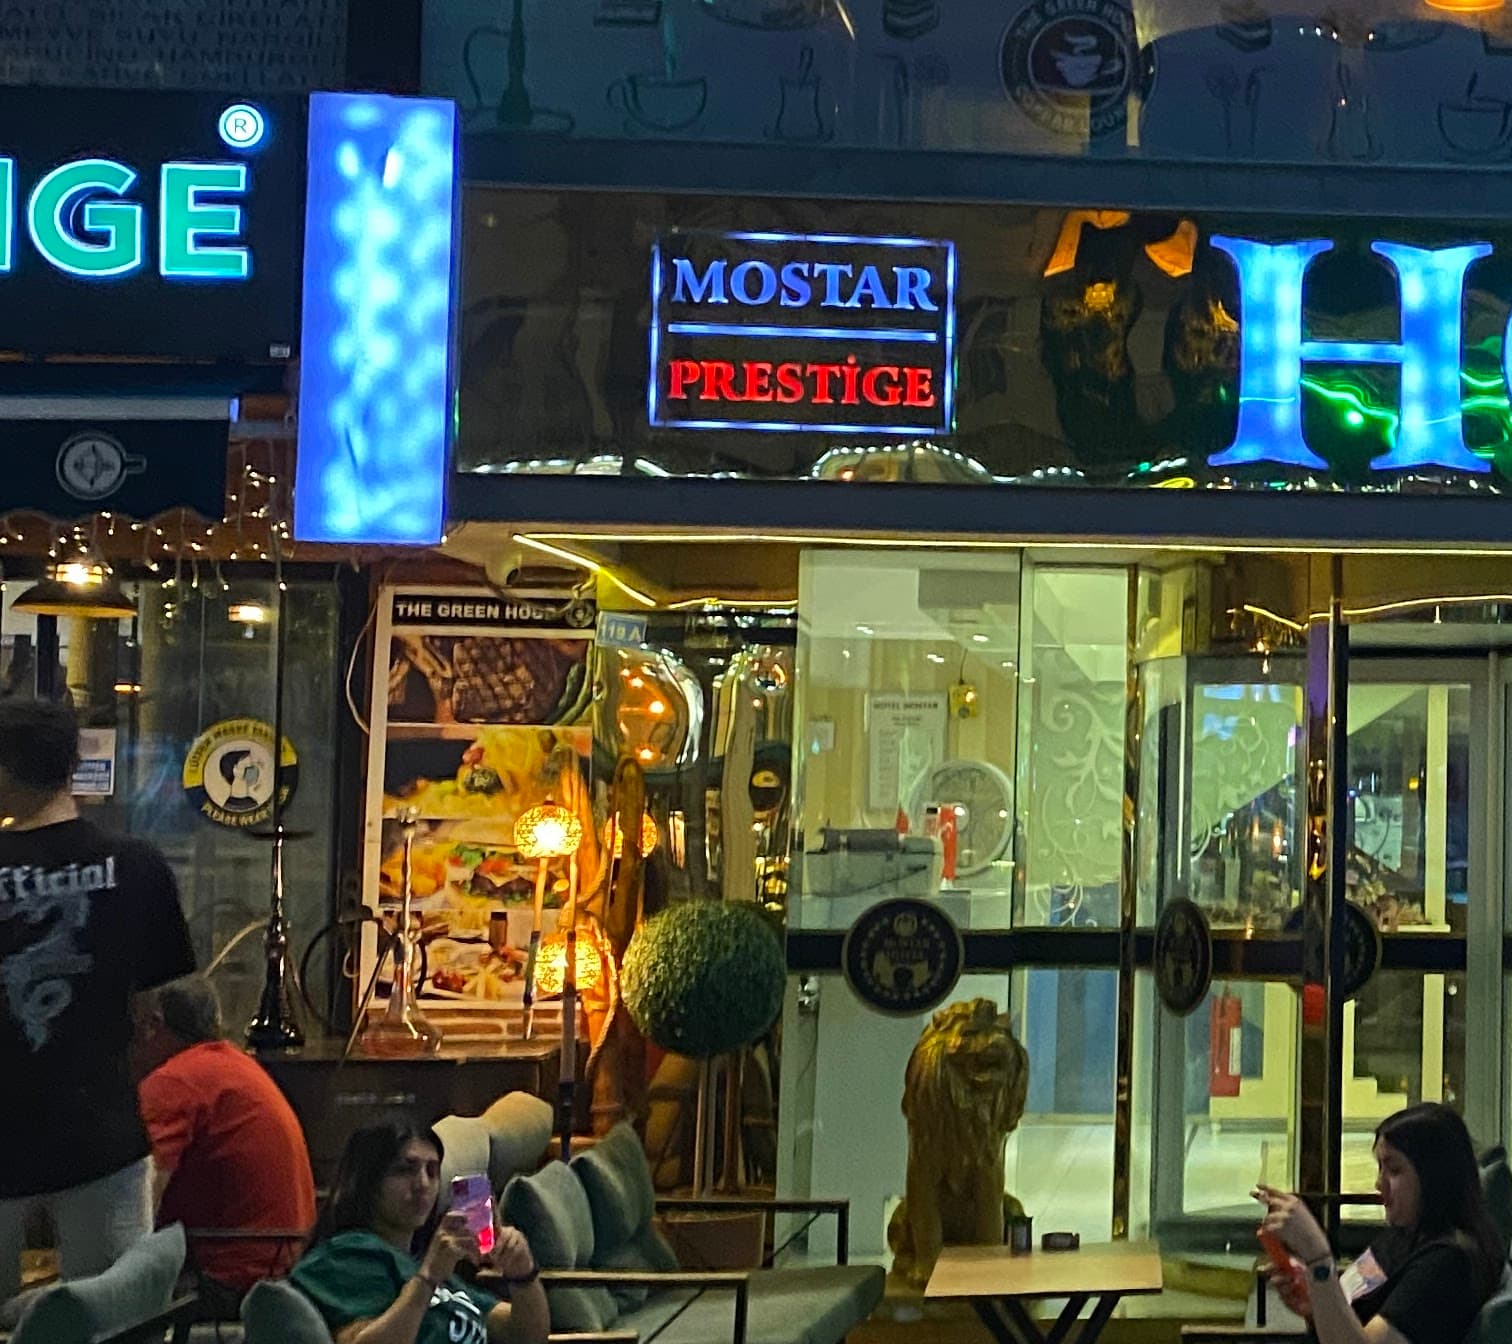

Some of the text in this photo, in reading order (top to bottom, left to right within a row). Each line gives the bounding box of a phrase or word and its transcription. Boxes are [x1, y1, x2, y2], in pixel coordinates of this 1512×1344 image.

[671, 257, 939, 311] MOSTAR
[667, 353, 935, 408] PRESTİGE
[396, 601, 432, 618] THE
[437, 602, 500, 619] GREEN
